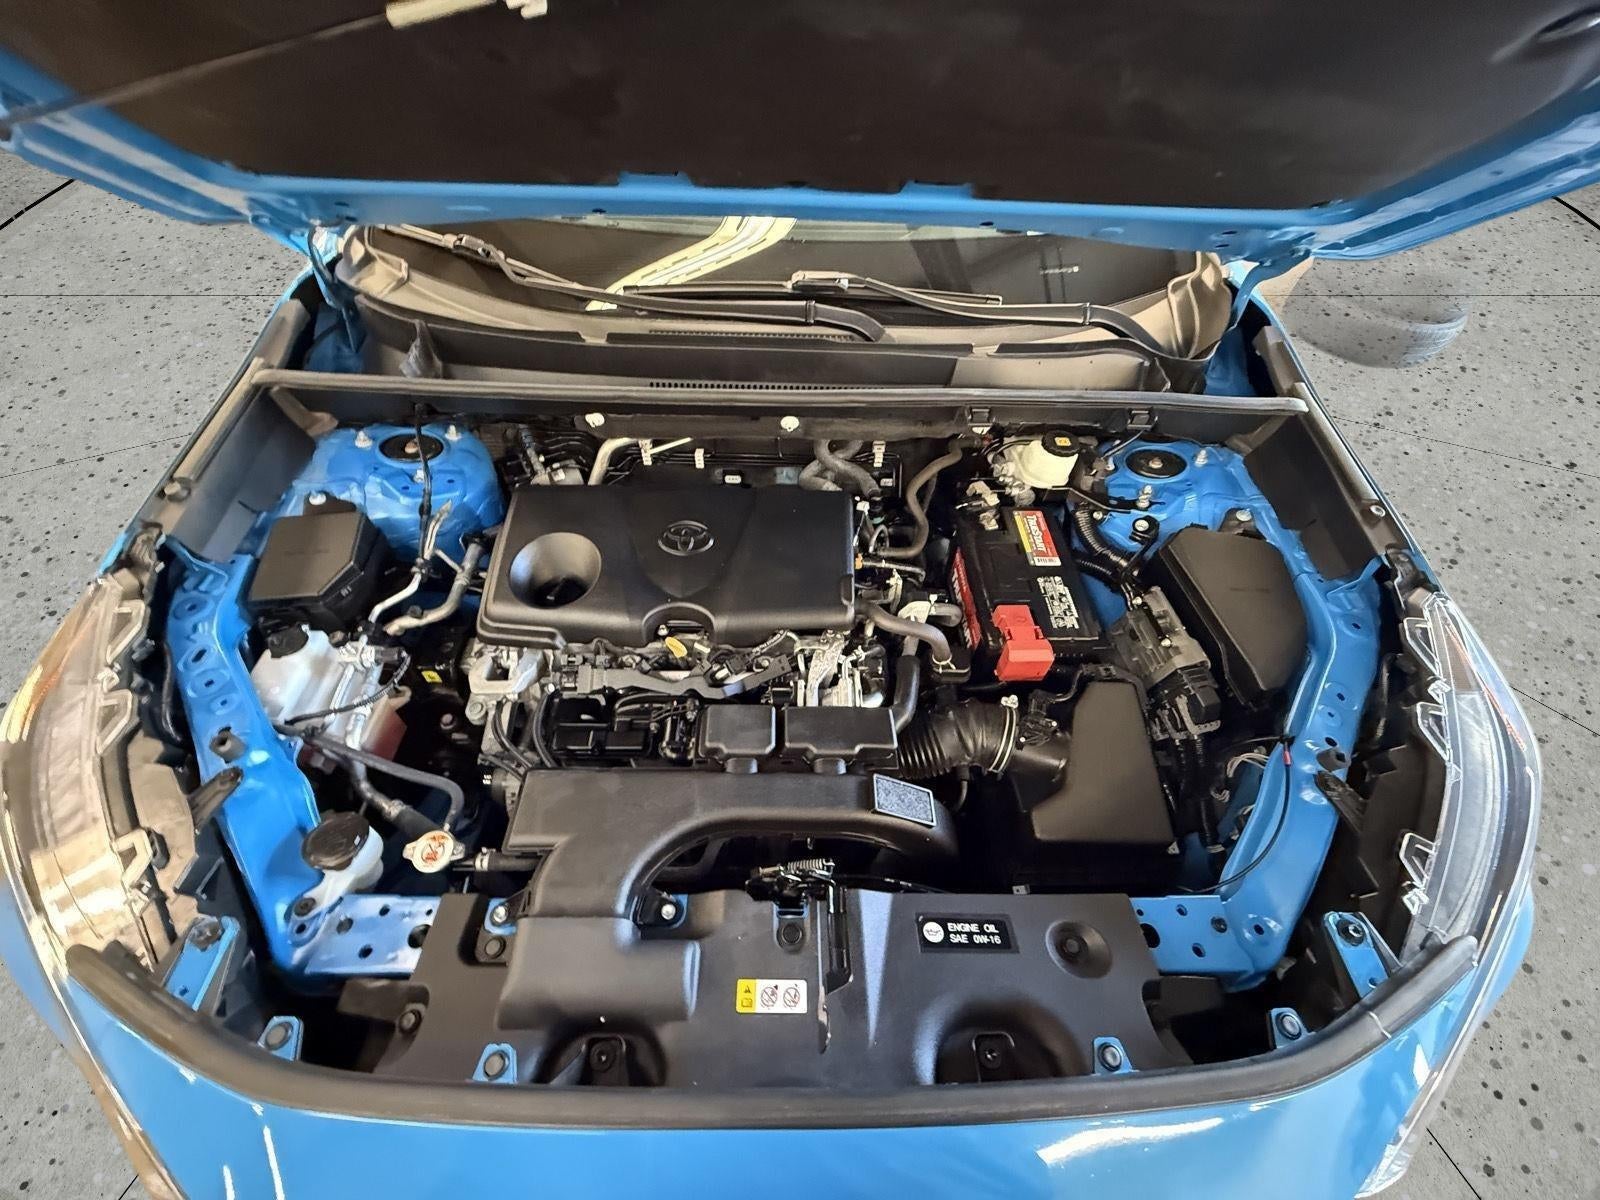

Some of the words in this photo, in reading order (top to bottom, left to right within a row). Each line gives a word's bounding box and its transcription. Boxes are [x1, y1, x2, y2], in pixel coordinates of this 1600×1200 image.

[947, 922, 980, 933] ENGINE
[983, 923, 1000, 933] OIL
[949, 933, 969, 944] SAE
[973, 934, 1001, 945] 0W-16
